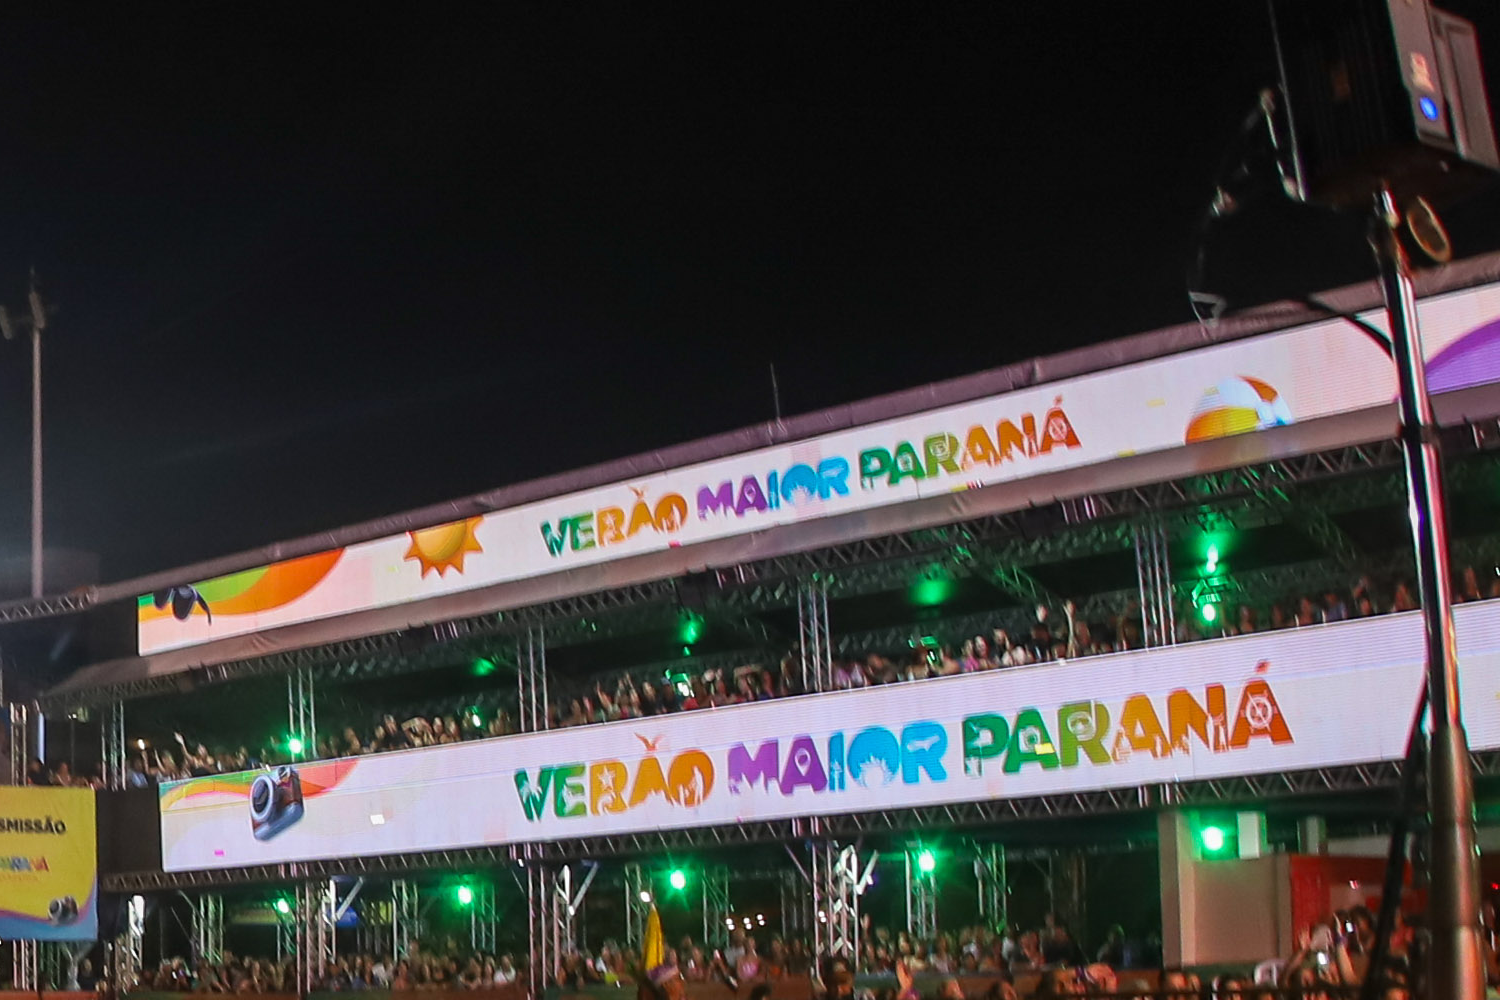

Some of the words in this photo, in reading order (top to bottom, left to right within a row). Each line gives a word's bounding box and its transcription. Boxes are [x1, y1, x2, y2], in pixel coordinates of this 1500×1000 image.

[540, 485, 687, 558] VERÃO
[697, 456, 850, 521] MAIOR
[858, 394, 1082, 490] PARANÁ
[514, 731, 714, 823] VERÃO
[727, 719, 947, 796] MAIOR
[962, 660, 1293, 779] PARANÁ
